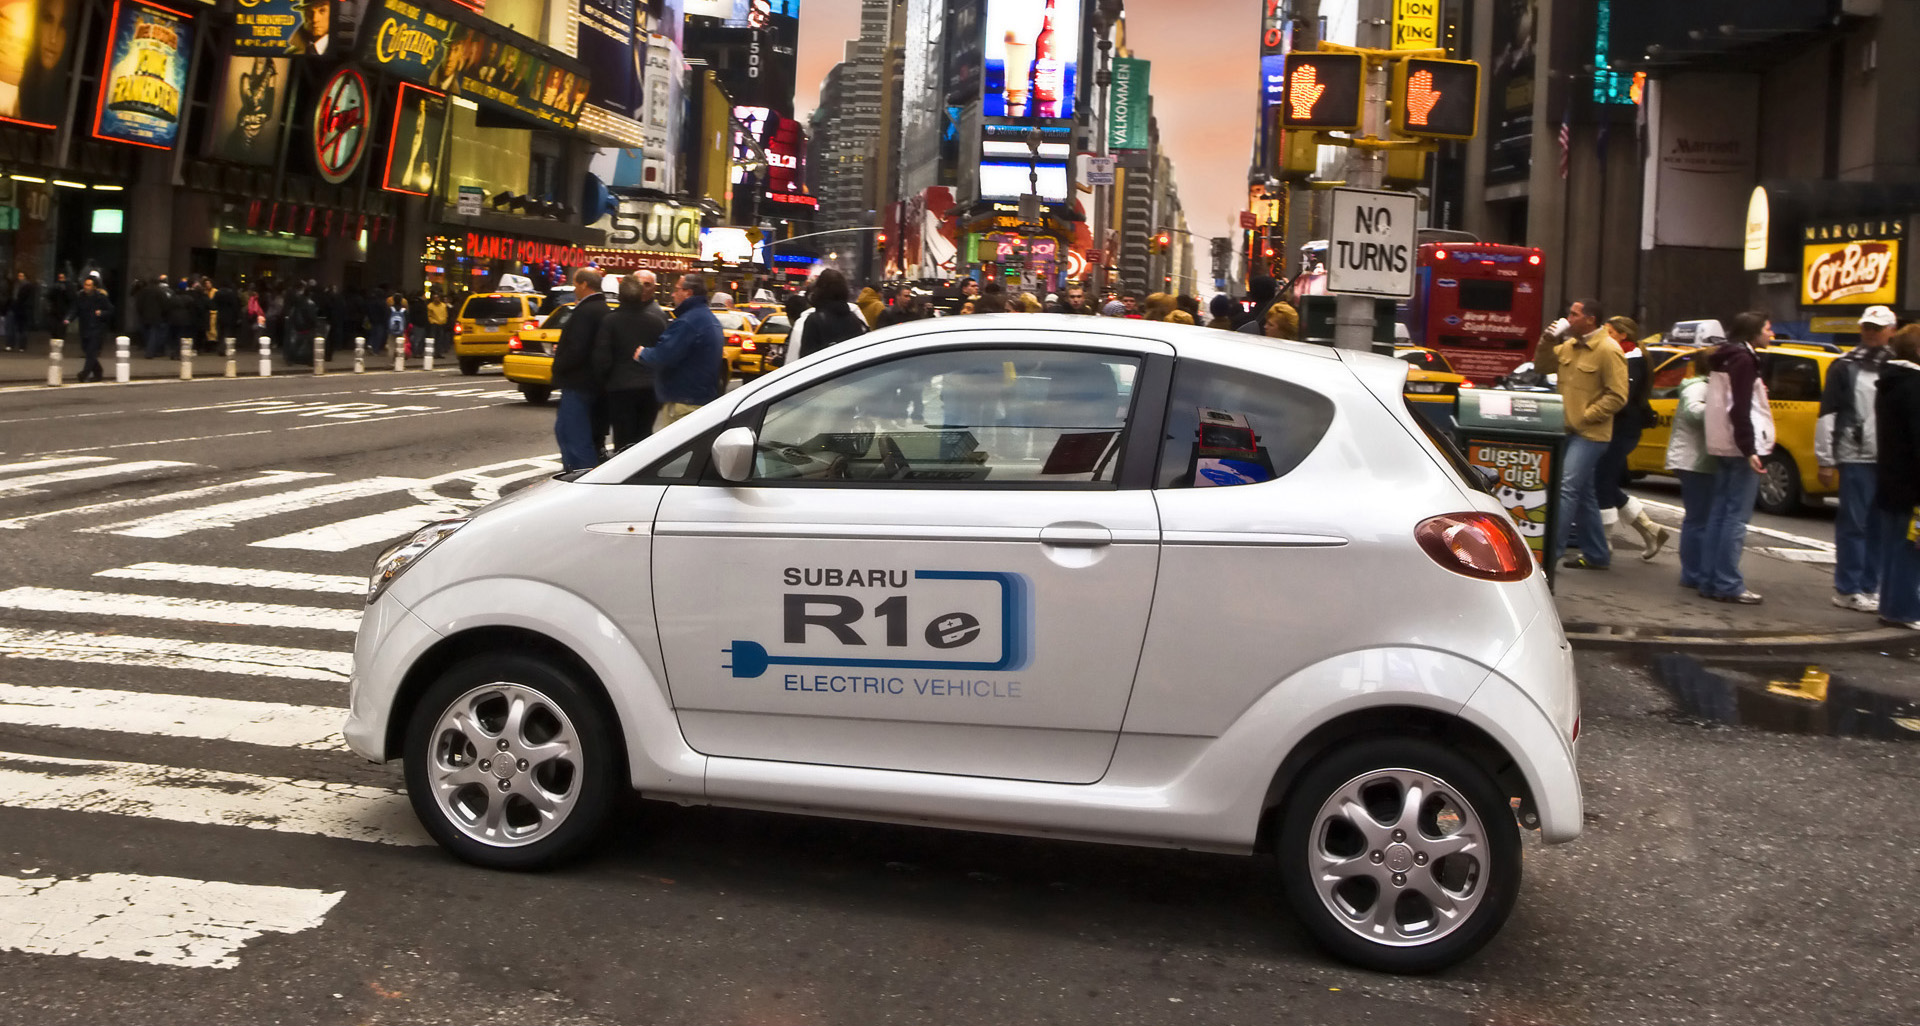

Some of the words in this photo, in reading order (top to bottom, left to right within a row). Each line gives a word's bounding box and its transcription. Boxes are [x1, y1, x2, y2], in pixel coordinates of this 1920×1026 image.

[1396, 24, 1433, 44] KING
[748, 30, 760, 78] 1500
[1355, 205, 1392, 235] NO
[1805, 221, 1903, 240] MARQUIS
[466, 232, 514, 260] PLANET
[517, 240, 584, 268] HOLLYWOOD
[1337, 240, 1408, 273] TURNS
[1478, 446, 1543, 469] digsby
[1504, 465, 1542, 488] dig!
[783, 567, 908, 588] SUBARU
[784, 674, 904, 695] ELECTRIC
[913, 678, 1022, 698] VEHICLE
